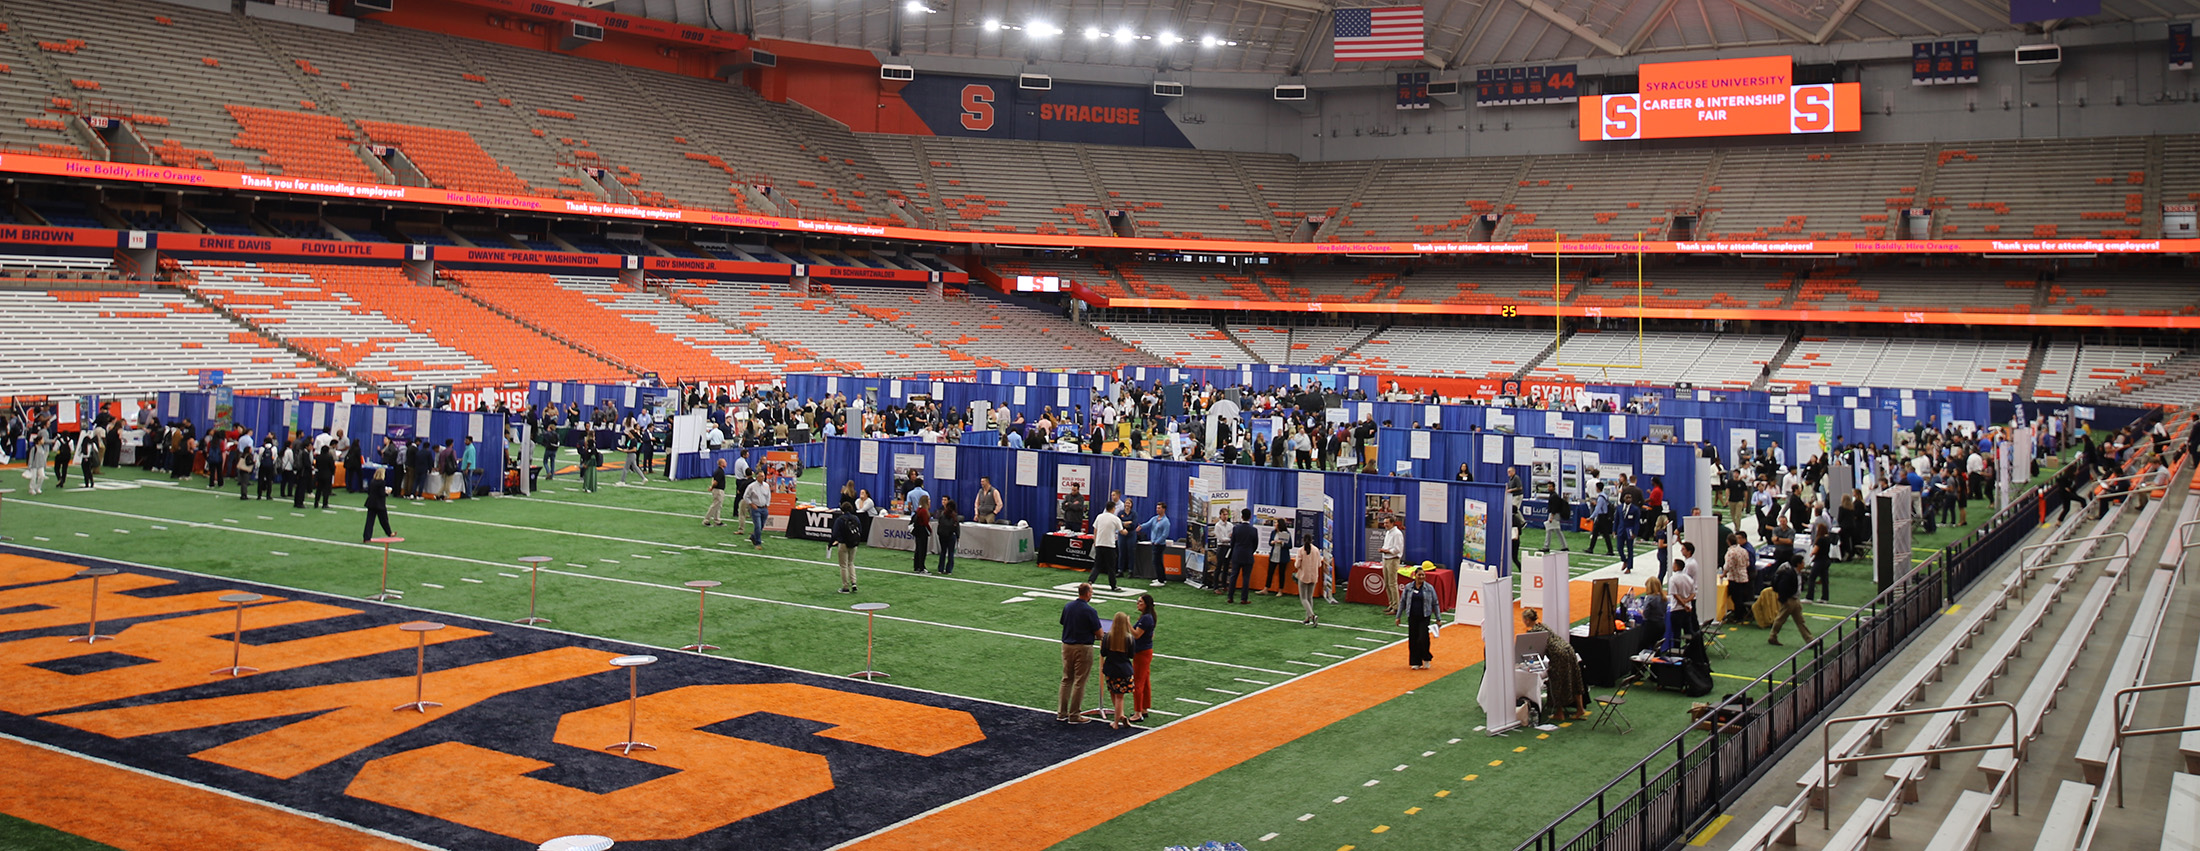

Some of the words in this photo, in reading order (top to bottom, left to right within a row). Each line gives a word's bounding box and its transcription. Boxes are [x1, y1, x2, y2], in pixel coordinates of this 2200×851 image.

[1548, 72, 1575, 90] 44
[1646, 80, 1708, 92] SYRACUSE
[1711, 76, 1786, 88] UNIVERSITY
[1643, 98, 1692, 110] CAREER
[1694, 98, 1705, 108] &
[1707, 94, 1786, 108] INTERNSHIP
[1040, 103, 1140, 125] SYRACUSE
[1698, 110, 1727, 121] FAIR
[66, 162, 91, 173] Hire
[94, 164, 133, 178] Boldly.
[136, 168, 160, 178] Hire
[163, 170, 206, 183] Orange.
[241, 174, 272, 188] Thank
[274, 180, 292, 190] you
[294, 179, 309, 190] for
[310, 182, 354, 196] attending
[356, 186, 404, 198] employers!
[447, 192, 464, 202] Hire
[466, 194, 492, 205] Boldly.
[494, 196, 510, 206] Hire
[512, 198, 542, 209] Orange.
[566, 202, 588, 212] Thank
[589, 204, 602, 214] you
[603, 204, 614, 214] for
[614, 206, 646, 218] attending
[646, 209, 682, 220] employers!
[22, 229, 74, 242] BROWN
[200, 238, 235, 250] ERNIE
[238, 240, 272, 250] DAVIS
[302, 242, 336, 254] FLOYD
[338, 244, 372, 256] LITTLE
[1434, 244, 1446, 252] you
[1458, 244, 1490, 252] attending
[1490, 244, 1528, 252] employers!
[1676, 242, 1700, 250] Thank
[1701, 244, 1716, 252] you
[1717, 242, 1728, 250] for
[1730, 242, 1768, 252] attending
[1768, 242, 1813, 252] employers!
[1875, 242, 1904, 251] Boldly.
[1926, 242, 1961, 251] Orange.
[1992, 241, 2021, 250] Thank
[2022, 242, 2040, 252] you
[2042, 241, 2056, 250] for
[2058, 241, 2104, 252] attending
[2104, 240, 2160, 252] employers!
[468, 250, 505, 262] DWAYNE
[545, 254, 598, 265] WASHINGTON
[656, 260, 670, 268] ROY
[672, 260, 702, 270] SIMMONS
[830, 268, 842, 276] BEN
[842, 269, 896, 278] SCHWARTZWALDER
[1502, 305, 1517, 318] 25
[806, 512, 833, 528] WT
[884, 529, 915, 540] SKANS
[1534, 576, 1544, 588] B
[1468, 590, 1480, 604] A
